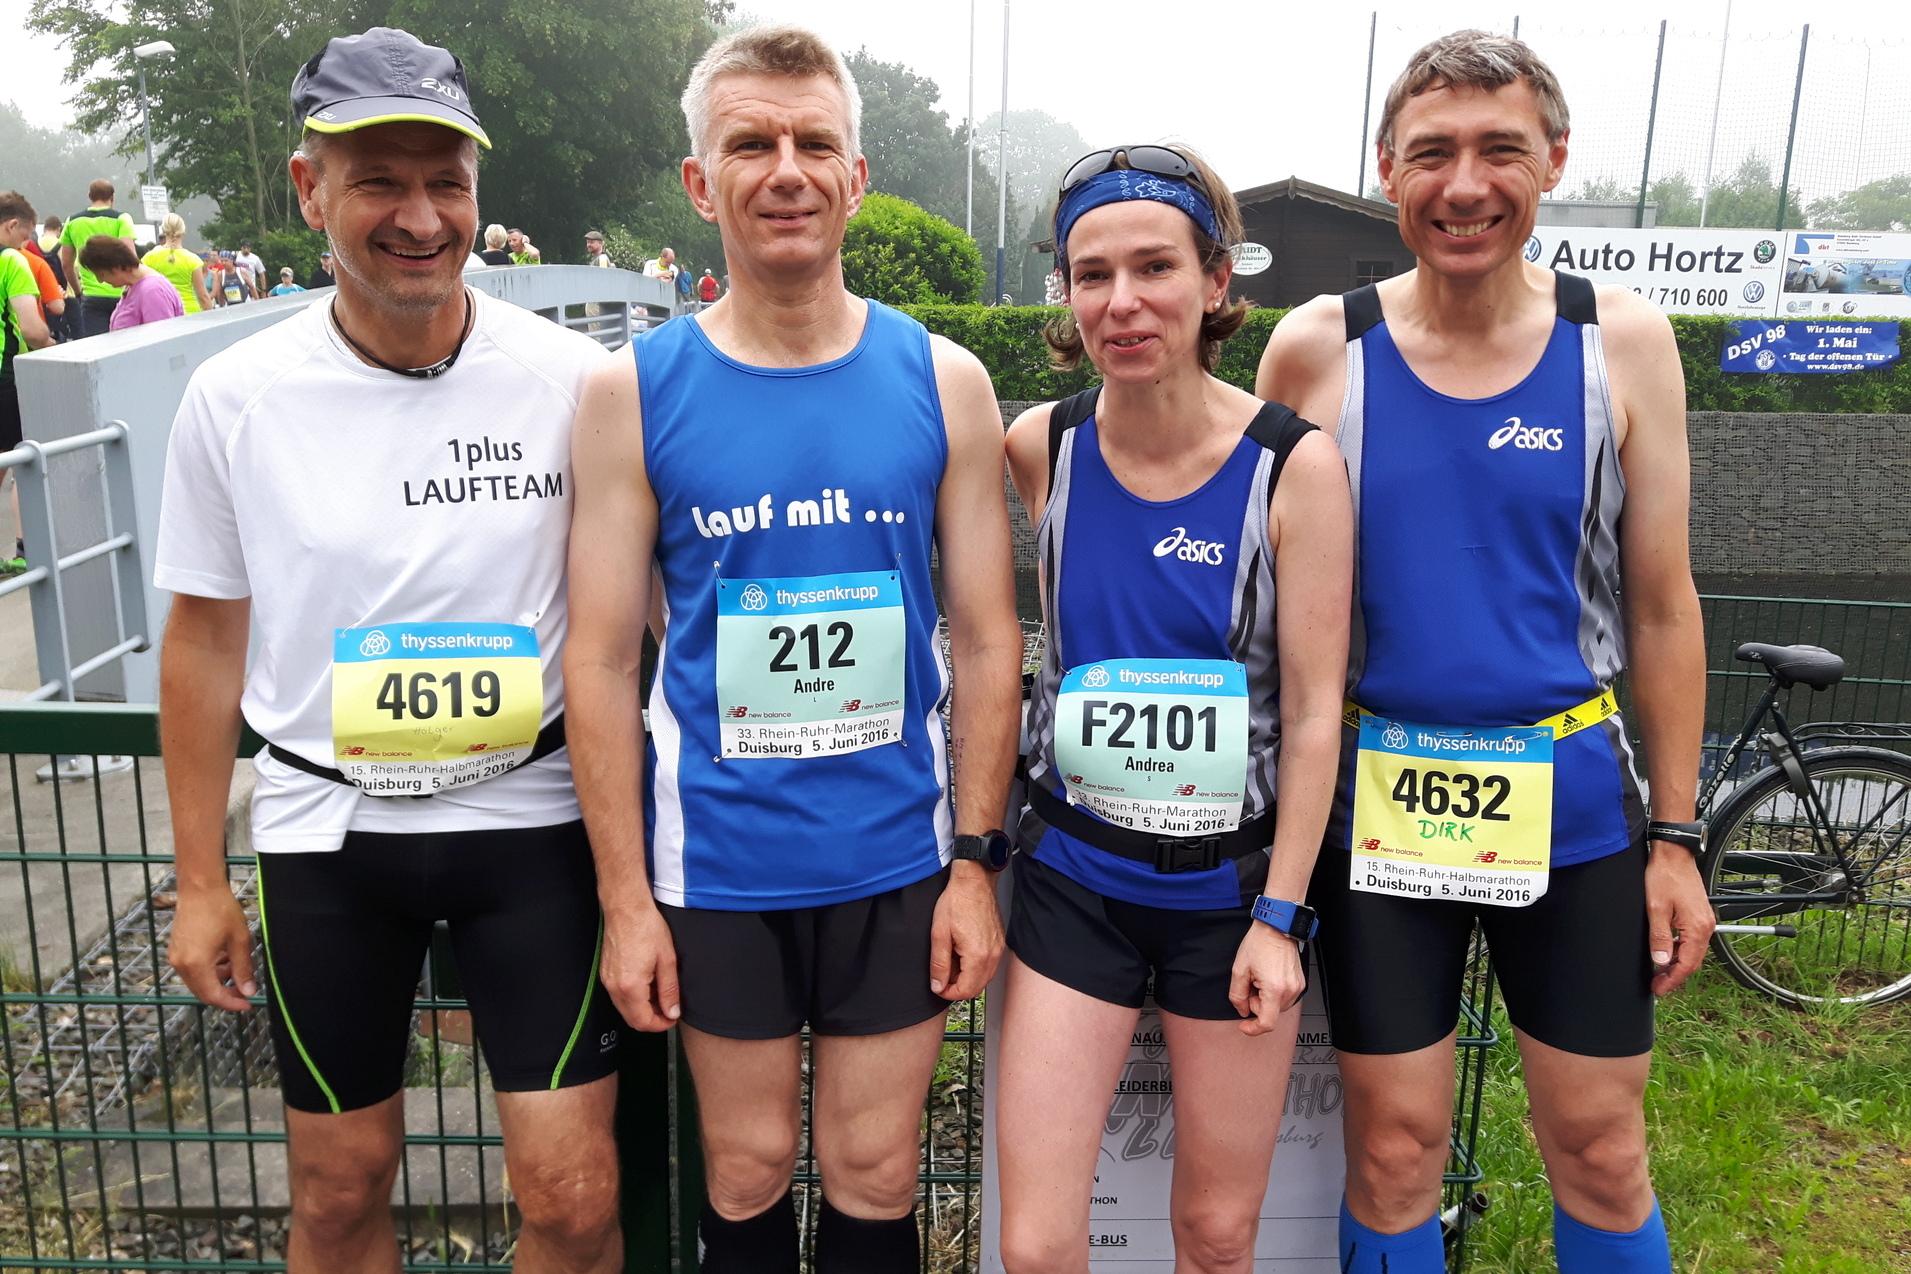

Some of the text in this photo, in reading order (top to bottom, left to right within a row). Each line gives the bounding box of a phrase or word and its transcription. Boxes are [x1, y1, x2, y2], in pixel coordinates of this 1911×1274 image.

[421, 77, 460, 101] 2XU
[1550, 240, 1744, 273] Auto Hortz
[1659, 288, 1690, 306] 710
[1696, 288, 1728, 306] 600
[1806, 325, 1872, 334] Wir laden ein:
[1727, 324, 1787, 361] DSV 98
[1817, 337, 1858, 348] 1. Mai
[1789, 352, 1885, 362] Tag der offenen Tür
[448, 436, 523, 471] 1plus
[403, 472, 563, 506] LAUFTEAM
[786, 488, 850, 527] mit
[777, 585, 878, 608] thyssenkrupp
[401, 632, 513, 652] thyssenkrupp
[769, 621, 856, 673] 212
[793, 677, 835, 694] Andre
[1120, 669, 1224, 688] thyssenkrupp
[376, 670, 500, 720] 4619
[875, 699, 900, 709] balance
[737, 717, 890, 739] 33. Rhein-Ruhr-Marathon
[1081, 700, 1217, 752] F2101
[1562, 720, 1585, 734] adidas
[738, 728, 889, 755] Duisburg 5. Juni 2016
[1417, 732, 1525, 754] thyssenkrupp
[350, 751, 515, 775] 15. Rhein-Ruhr-Halbmarathon
[432, 777, 445, 788] 5.
[449, 769, 480, 785] Juni
[484, 760, 515, 777] 2016
[1125, 756, 1174, 773] Andrea
[1098, 783, 1125, 792] balance
[1392, 768, 1511, 822] 4632
[1093, 797, 1227, 817] Rhein-Ruhr-Marathon
[1143, 816, 1155, 829] 5.
[1159, 818, 1190, 832] Juni
[1194, 818, 1225, 832] 2016
[1417, 819, 1476, 843] DIRK
[1395, 848, 1424, 857] balance
[1367, 861, 1531, 886] 15. Rhein-Ruhr-Halbmarathon
[1367, 874, 1530, 901] Duisburg 5. Juni 2016
